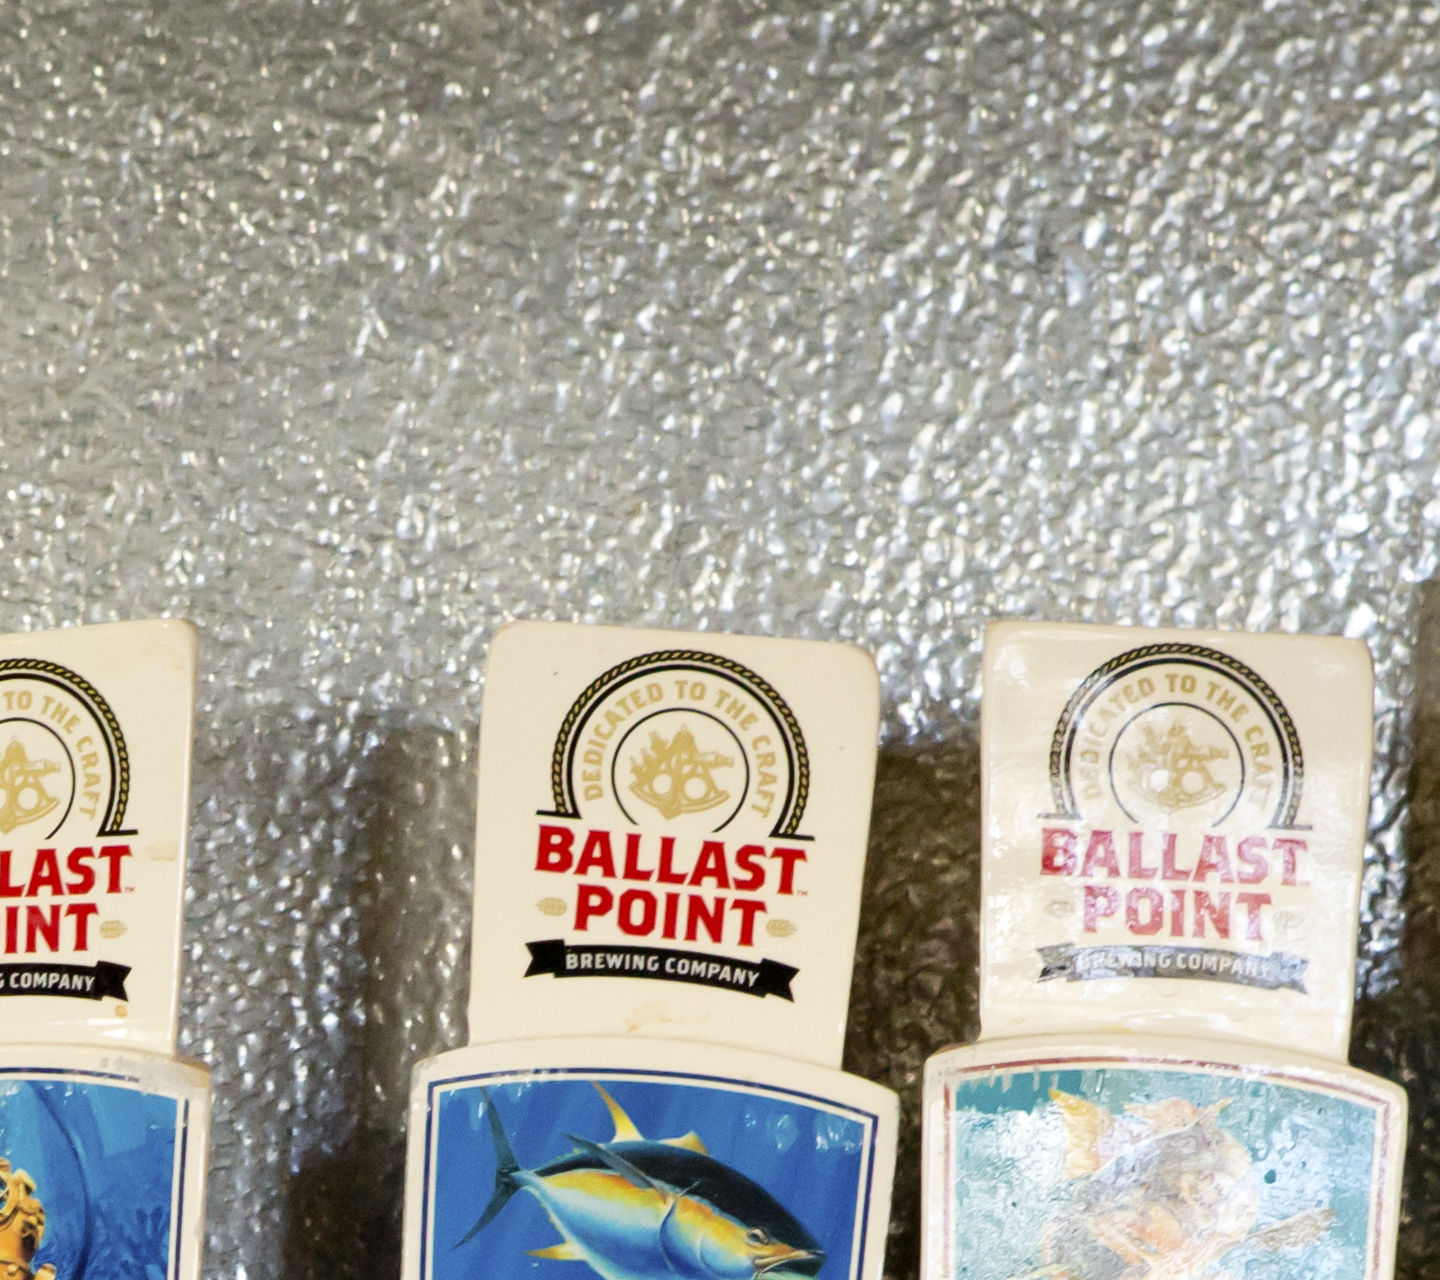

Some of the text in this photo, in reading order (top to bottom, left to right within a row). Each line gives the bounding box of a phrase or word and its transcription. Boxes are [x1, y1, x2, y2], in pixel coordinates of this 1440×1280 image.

[4, 691, 32, 710] TO
[42, 696, 81, 735] THE
[76, 735, 101, 820] CRAFT
[581, 680, 777, 818] DEDICATED TO THE CRAFT
[535, 824, 808, 895] BALLAST
[1040, 827, 1308, 887] BALLAST
[574, 884, 767, 947] POINT
[1083, 885, 1272, 941] POINT
[9, 972, 95, 990] COMPANY
[566, 953, 759, 987] BREWING COMPANY
[1176, 952, 1273, 977] COMPANY
